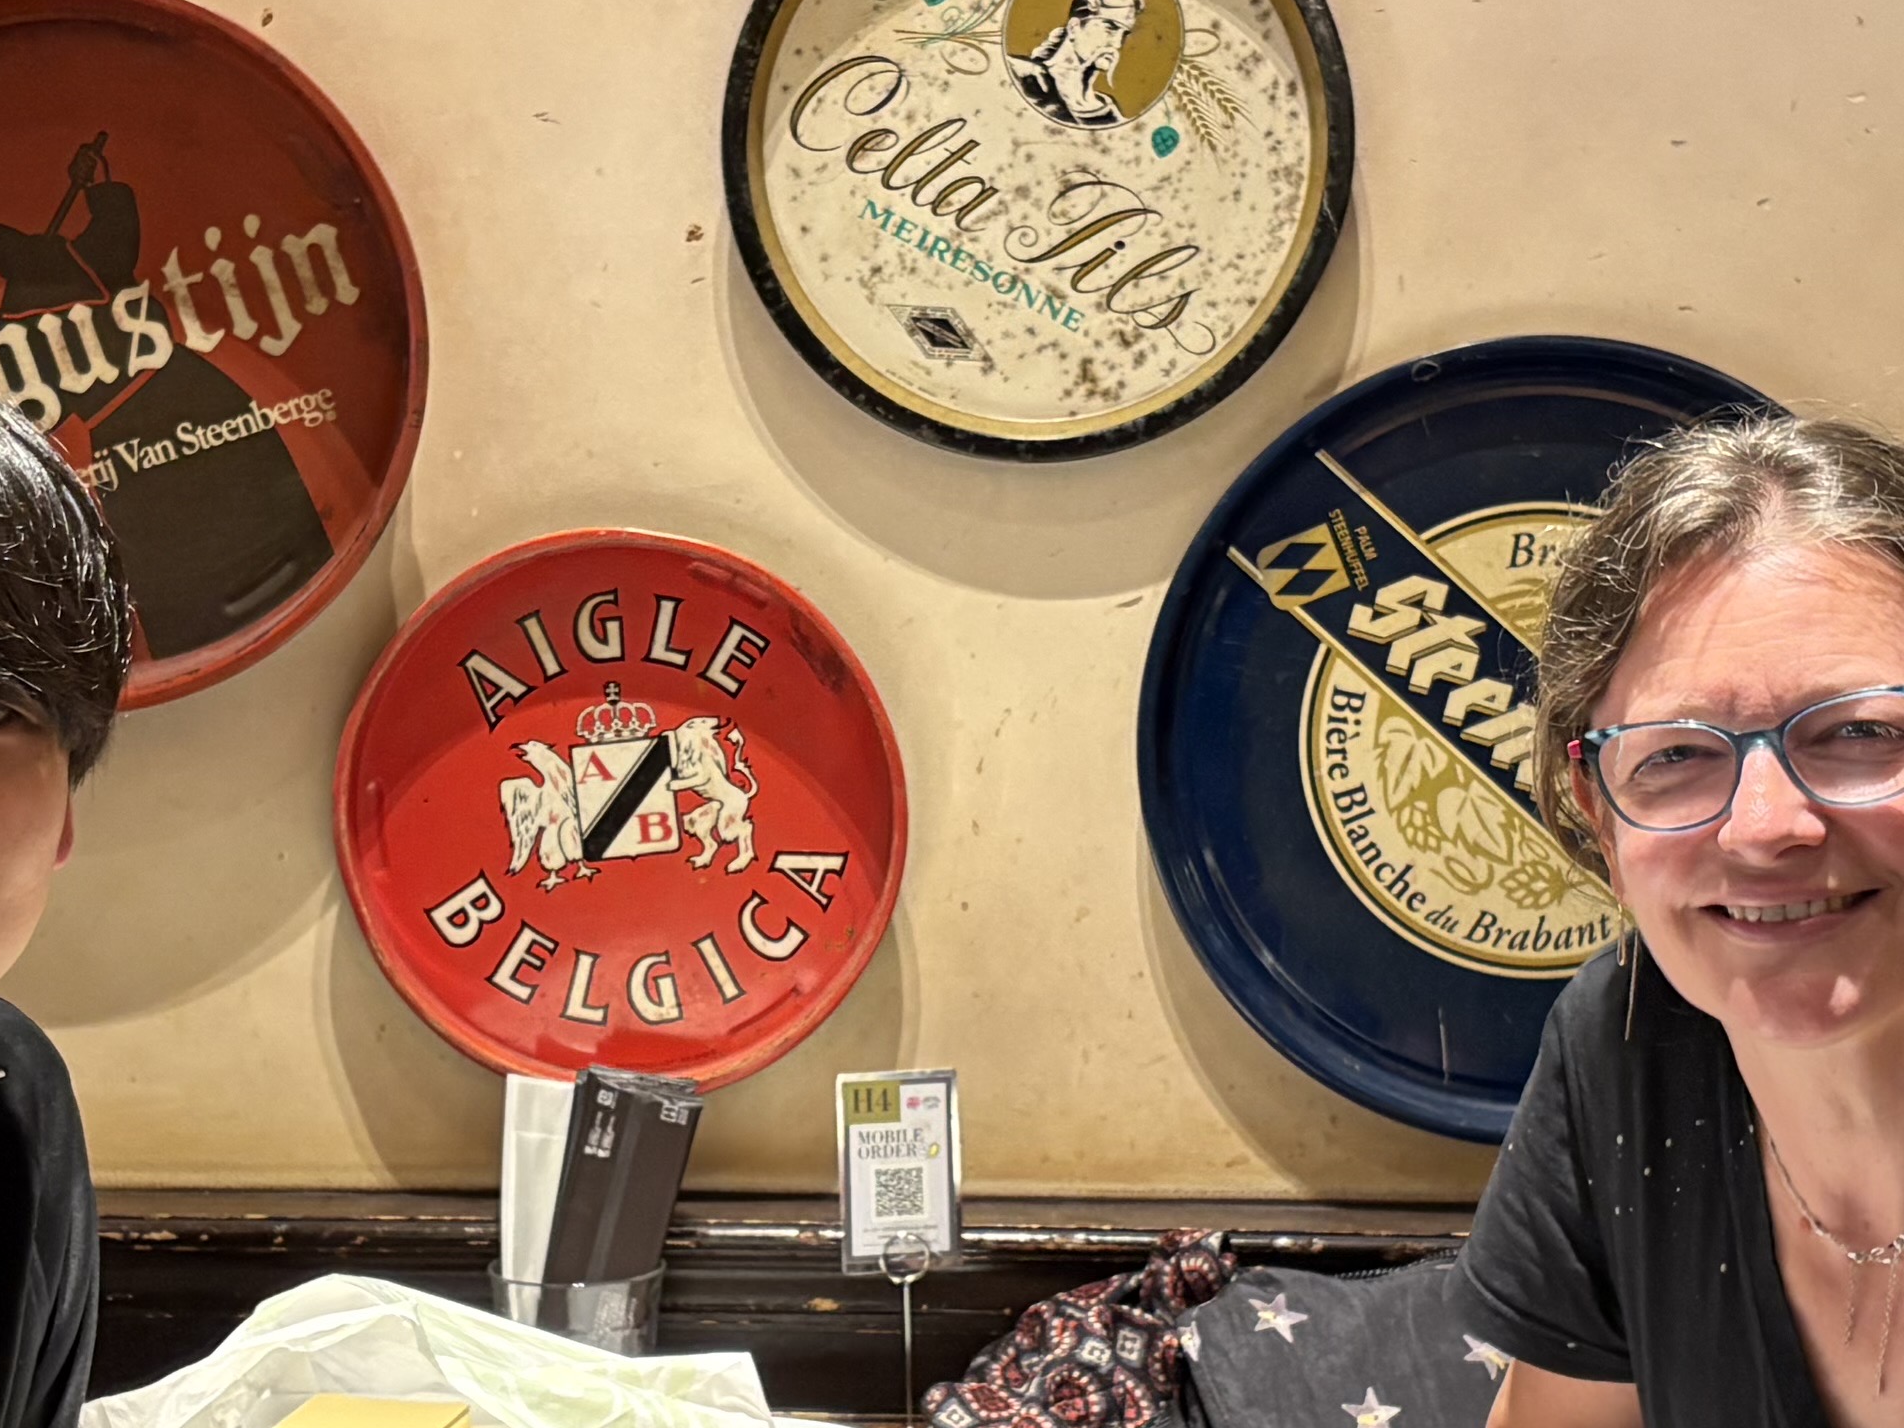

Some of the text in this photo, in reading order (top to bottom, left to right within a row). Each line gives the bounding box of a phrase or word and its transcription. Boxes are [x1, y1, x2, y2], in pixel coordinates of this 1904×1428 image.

[789, 54, 1217, 357] Celta Pils
[857, 197, 1086, 334] MEIRESONNE
[112, 430, 179, 476] Van
[175, 385, 337, 458] Steenberge
[1353, 525, 1379, 563] PALM
[456, 587, 772, 732] AIGLE
[577, 751, 618, 785] A
[635, 810, 674, 845] B
[1326, 684, 1613, 955] Bière Blanche du Brabant
[424, 848, 850, 1027] BELGICA
[852, 1087, 894, 1115] H4
[857, 1127, 925, 1146] MOBILE
[857, 1143, 918, 1161] ORDER
